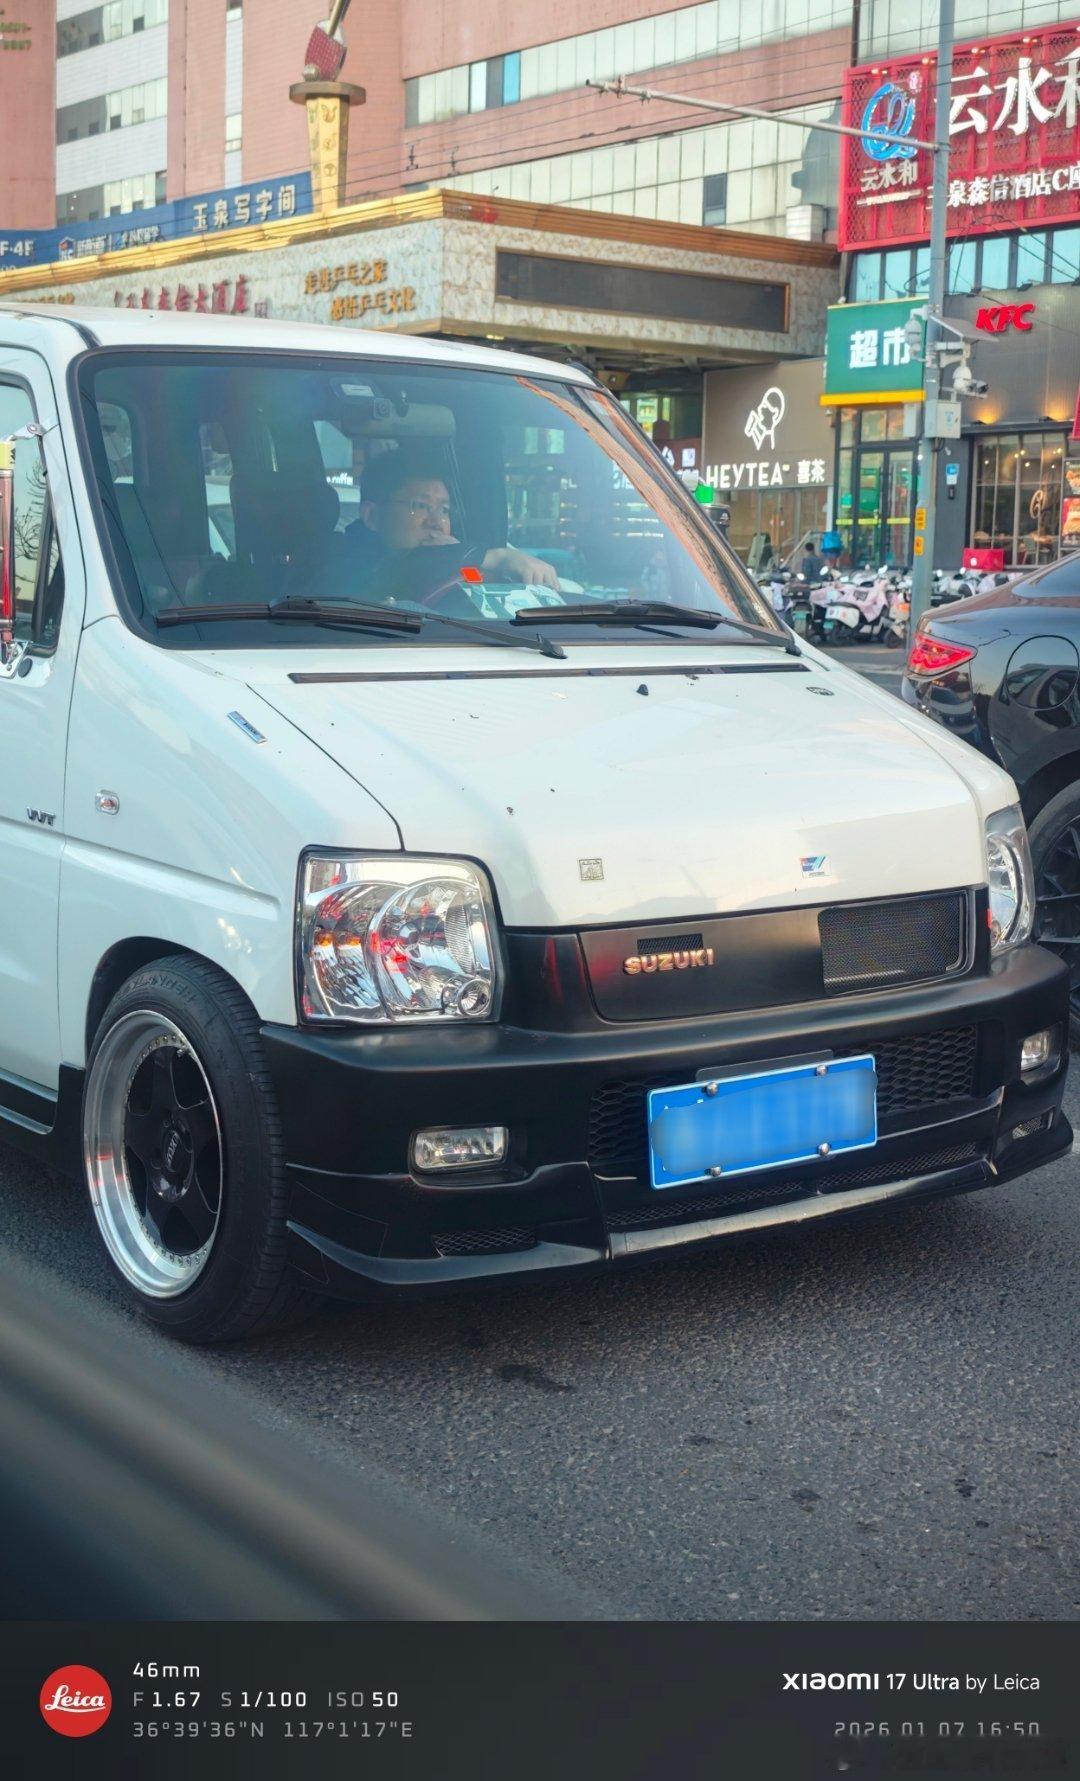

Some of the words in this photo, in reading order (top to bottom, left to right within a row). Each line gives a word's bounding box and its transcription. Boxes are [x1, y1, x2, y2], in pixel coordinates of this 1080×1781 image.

[860, 159, 918, 192] 云水和
[193, 184, 296, 232] 玉泉写字间
[976, 303, 1035, 334] KFC
[849, 327, 911, 369] 超市
[706, 462, 783, 488] HEYTEA
[797, 458, 826, 484] 喜茶
[623, 947, 715, 976] SUZUKI
